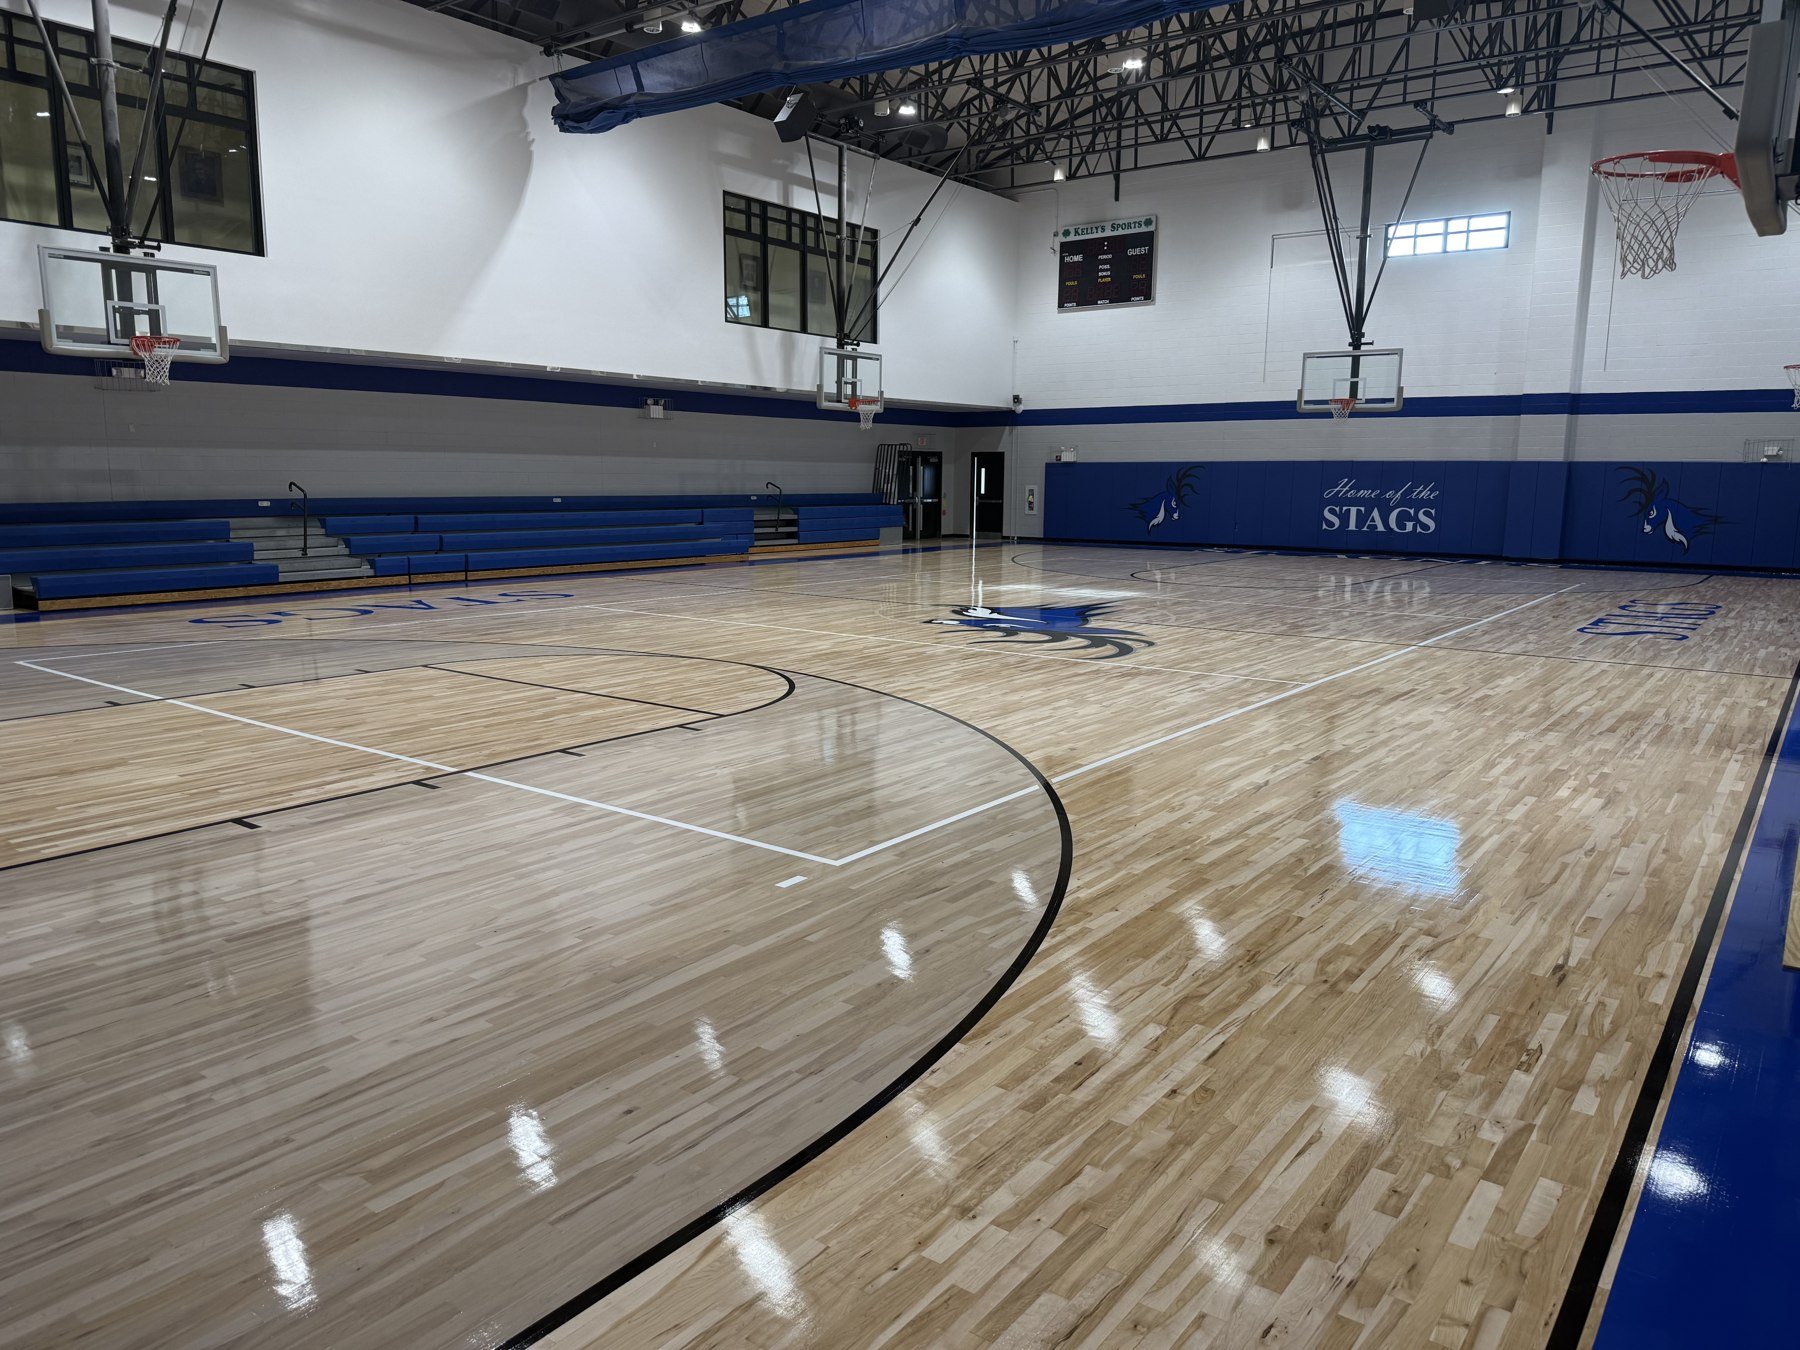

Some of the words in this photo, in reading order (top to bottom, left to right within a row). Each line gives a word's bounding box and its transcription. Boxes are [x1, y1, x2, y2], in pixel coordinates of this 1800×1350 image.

[1073, 225, 1106, 237] KELLY'S
[1110, 220, 1143, 232] SPORTS
[1064, 254, 1083, 263] HOME
[1127, 246, 1149, 256] GUEST
[1323, 478, 1380, 499] Home
[1381, 481, 1412, 506] of
[1406, 481, 1440, 500] the
[1322, 505, 1436, 534] STAGS
[188, 590, 574, 628] STAGS
